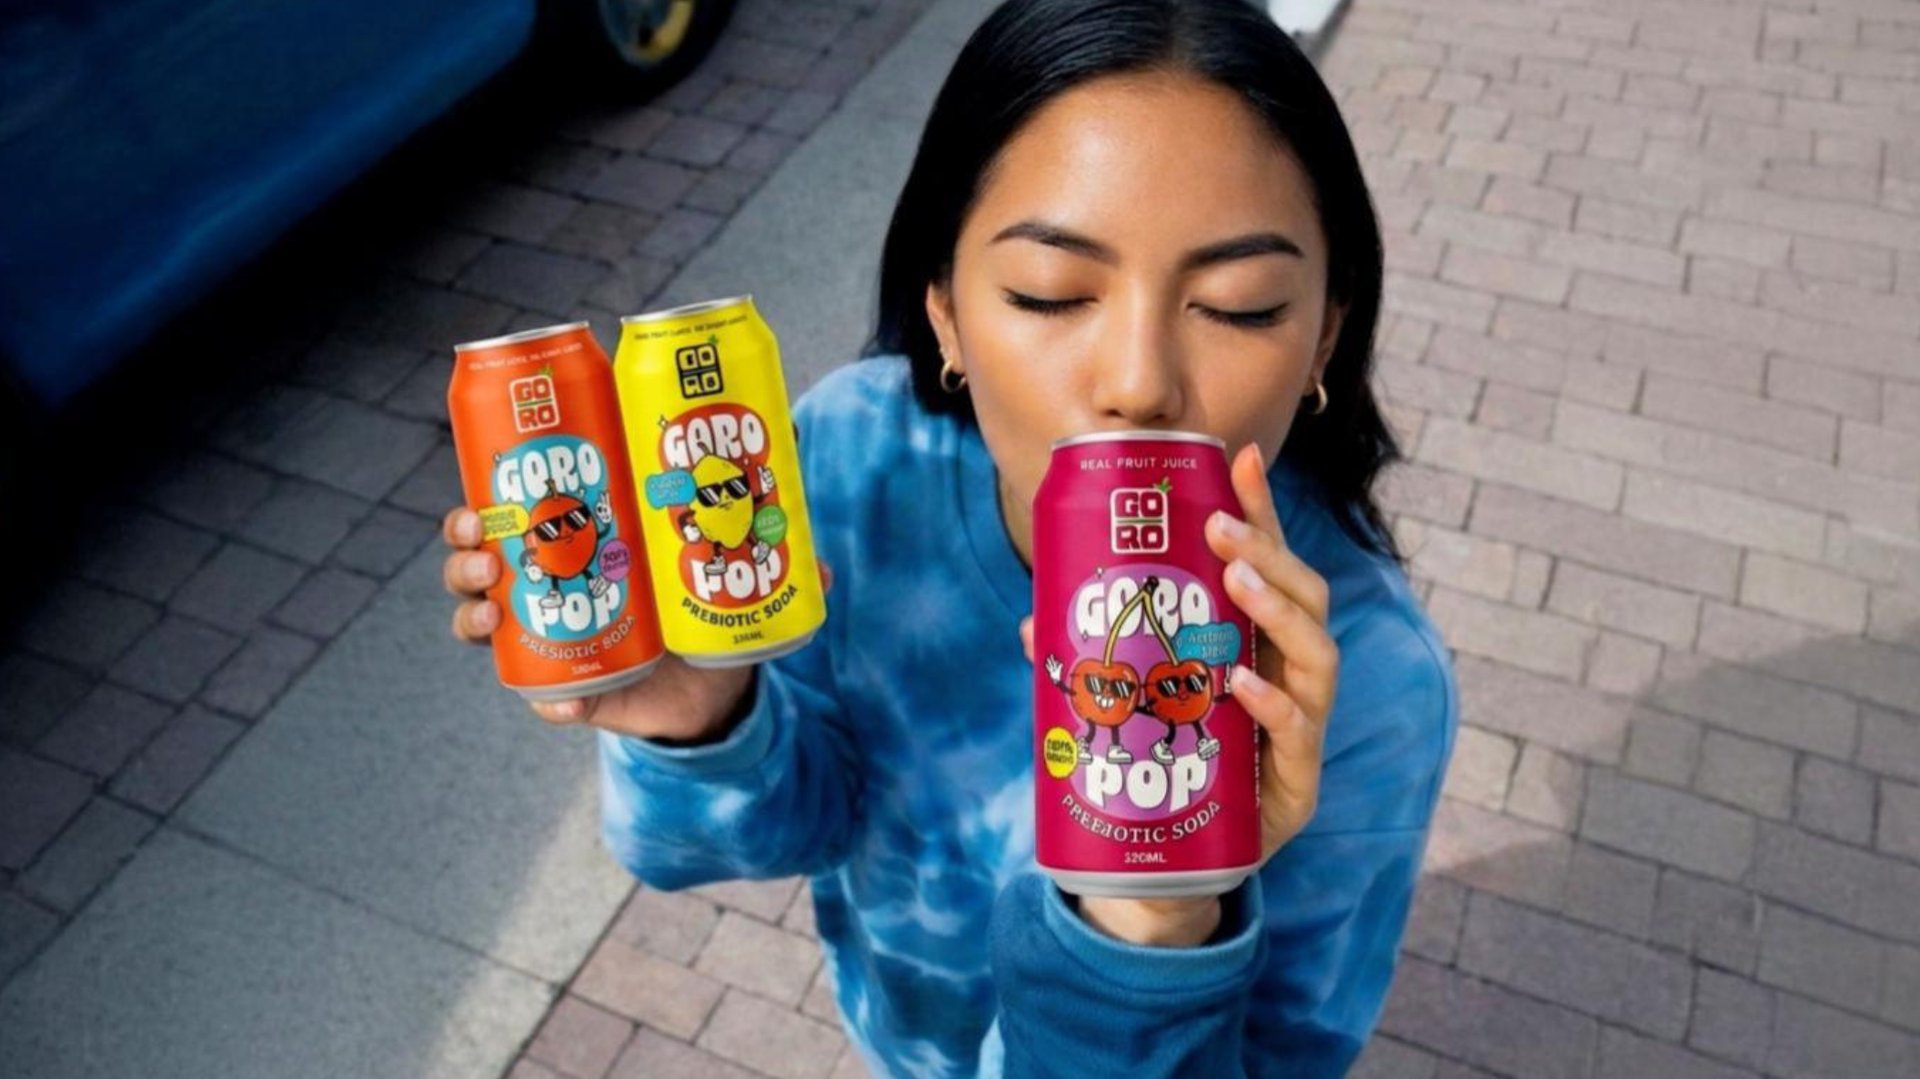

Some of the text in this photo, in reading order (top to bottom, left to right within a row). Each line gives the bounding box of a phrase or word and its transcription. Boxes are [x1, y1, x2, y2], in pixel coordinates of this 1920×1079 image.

[517, 404, 557, 429] RO
[496, 442, 601, 503] GORO
[1117, 457, 1157, 469] FRUIT
[1162, 457, 1198, 470] JUICE
[1115, 491, 1164, 518] GO
[1115, 524, 1165, 550] RO
[690, 548, 782, 601] POP
[525, 582, 621, 638] POP
[682, 583, 799, 628] PREBIOTIC SODA
[1075, 576, 1210, 638] GORO
[1085, 752, 1208, 813] POP
[1171, 801, 1221, 840] SODA
